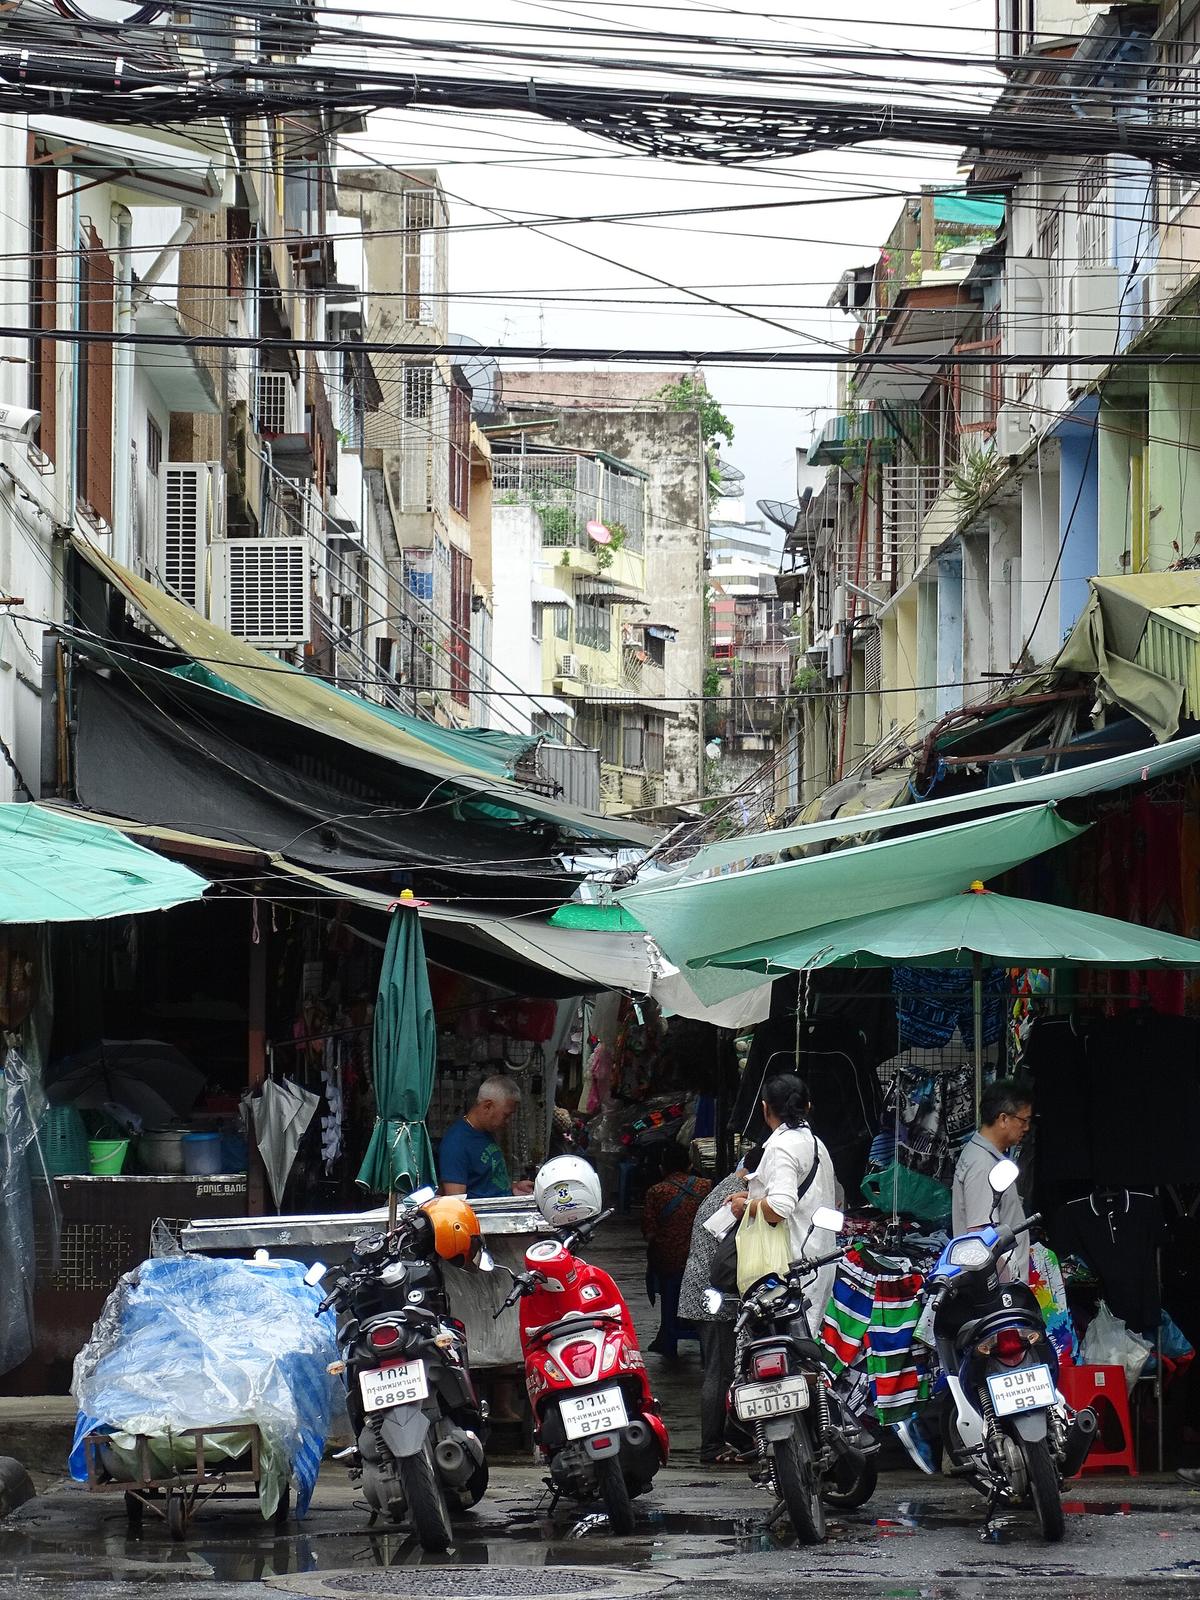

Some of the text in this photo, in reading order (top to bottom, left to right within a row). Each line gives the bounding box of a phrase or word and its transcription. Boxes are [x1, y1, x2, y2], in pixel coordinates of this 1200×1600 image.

[196, 1184, 222, 1196] SONIC
[224, 1184, 247, 1192] BANG
[375, 1388, 417, 1406] 6895
[1015, 1395, 1036, 1409] 93
[581, 1416, 612, 1433] 873
